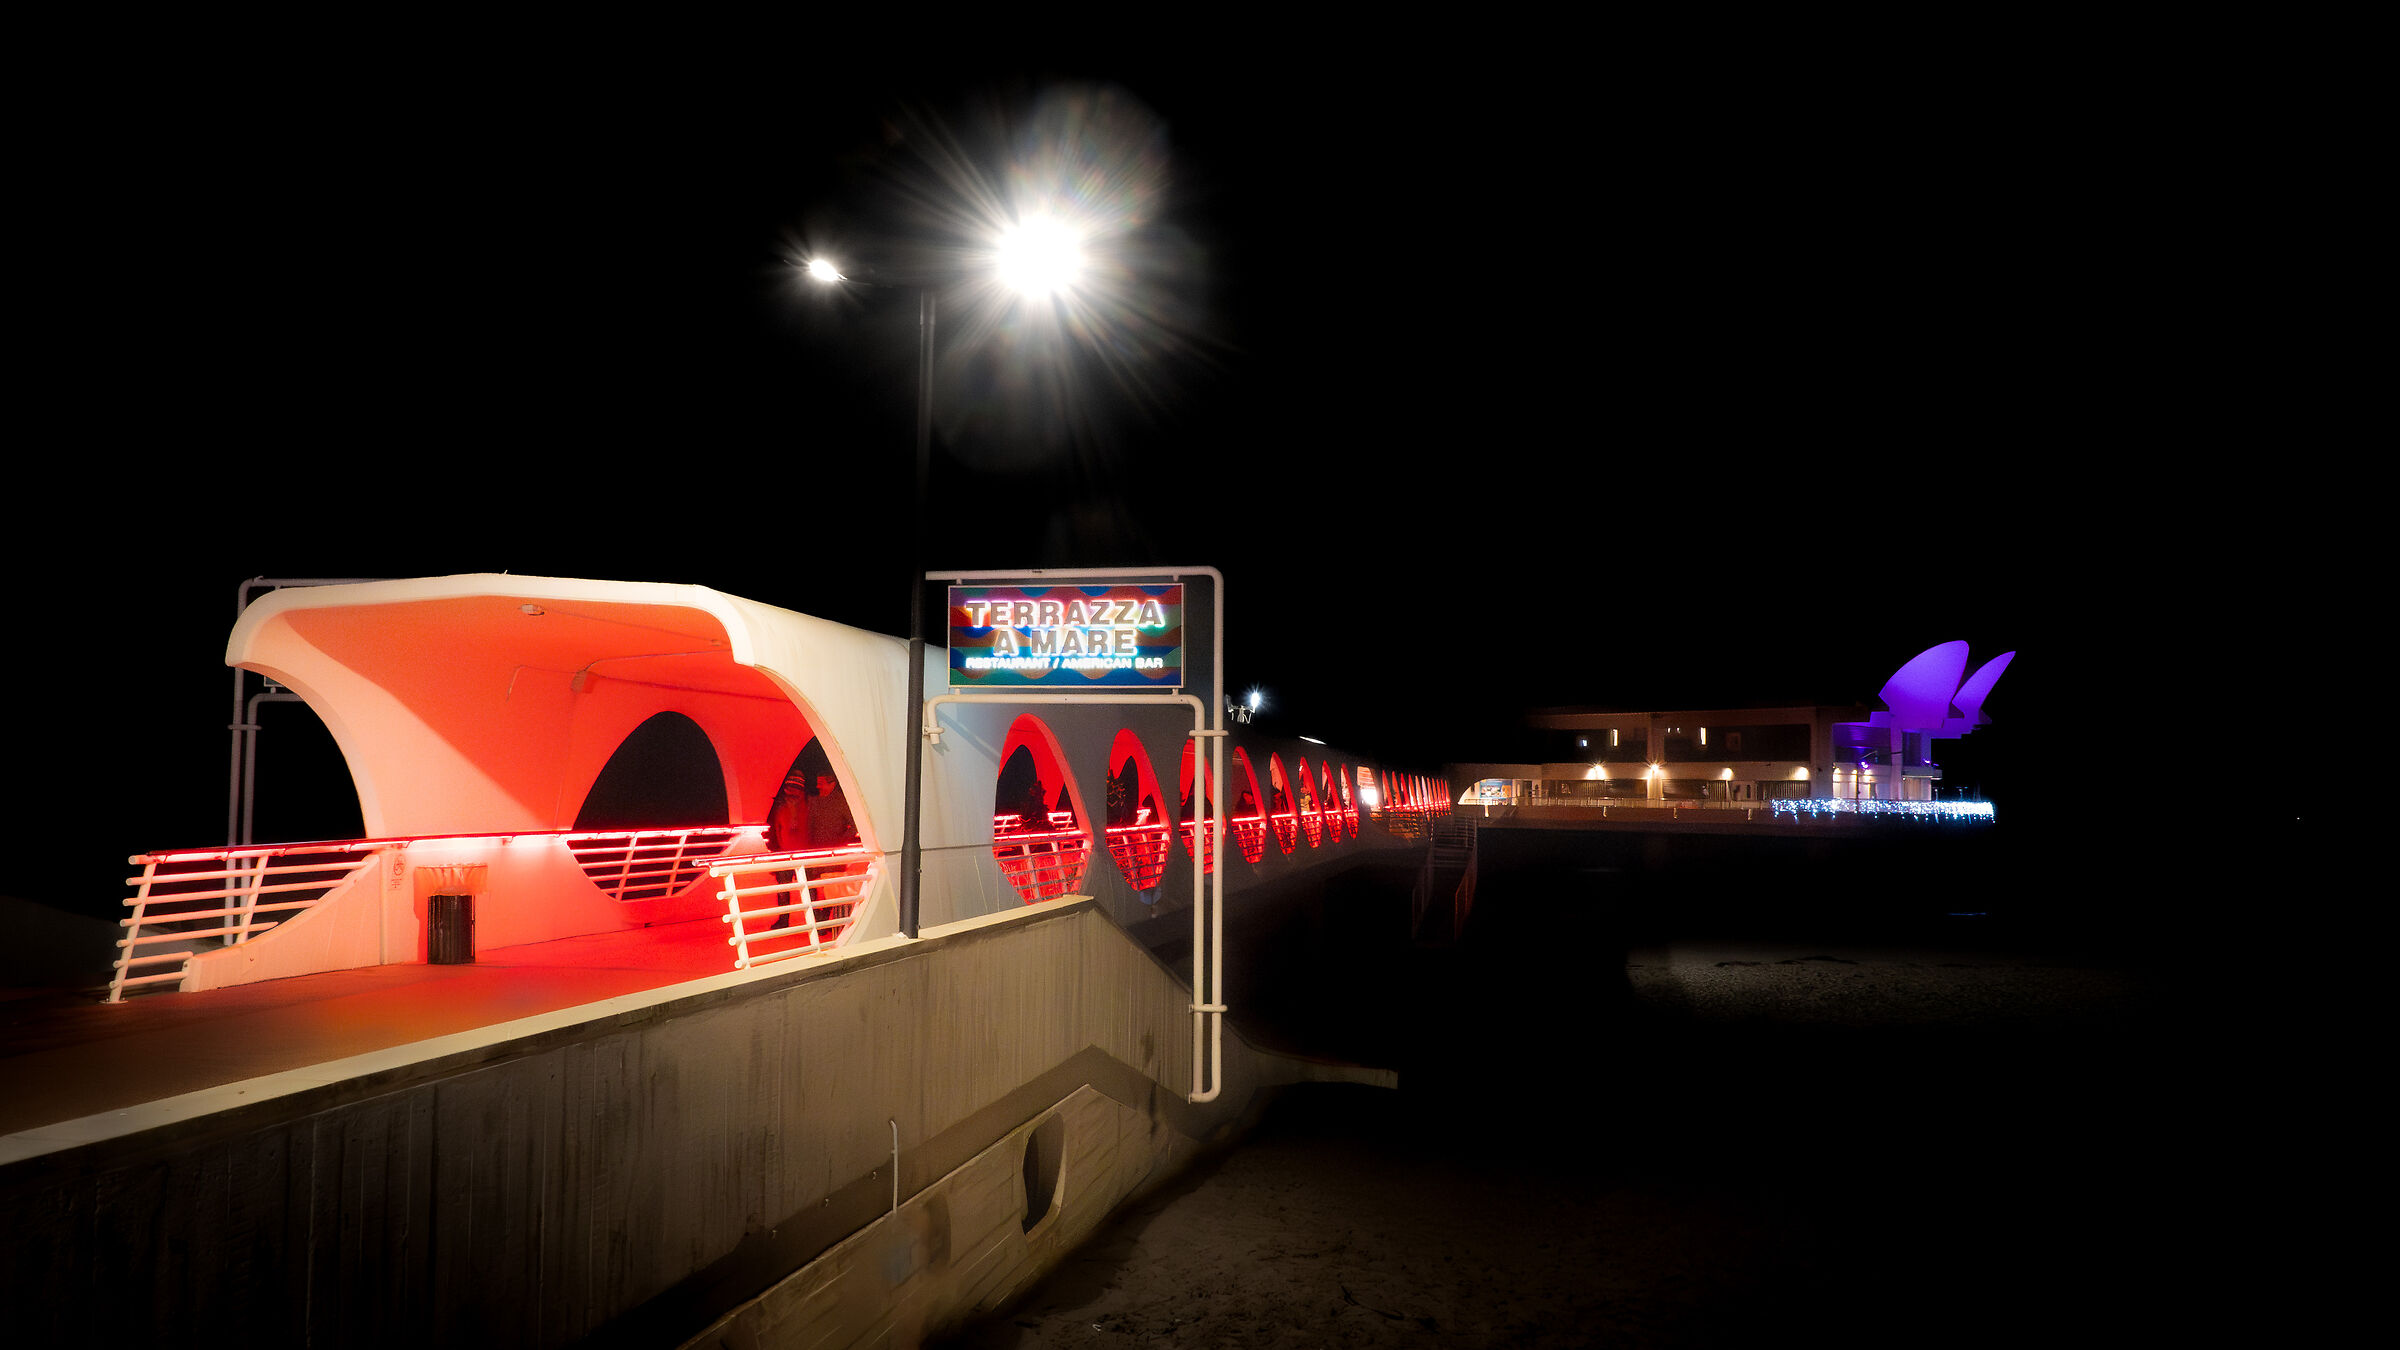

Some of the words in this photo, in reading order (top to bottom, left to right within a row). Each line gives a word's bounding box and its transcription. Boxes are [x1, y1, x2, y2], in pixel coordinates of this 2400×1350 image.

[966, 600, 1165, 627] TERRAZZA
[993, 630, 1018, 656] A
[1031, 629, 1138, 656] MARE
[966, 657, 1051, 669] RESTAURANT
[1062, 658, 1132, 669] AMERICAN
[1135, 658, 1163, 669] BAR
